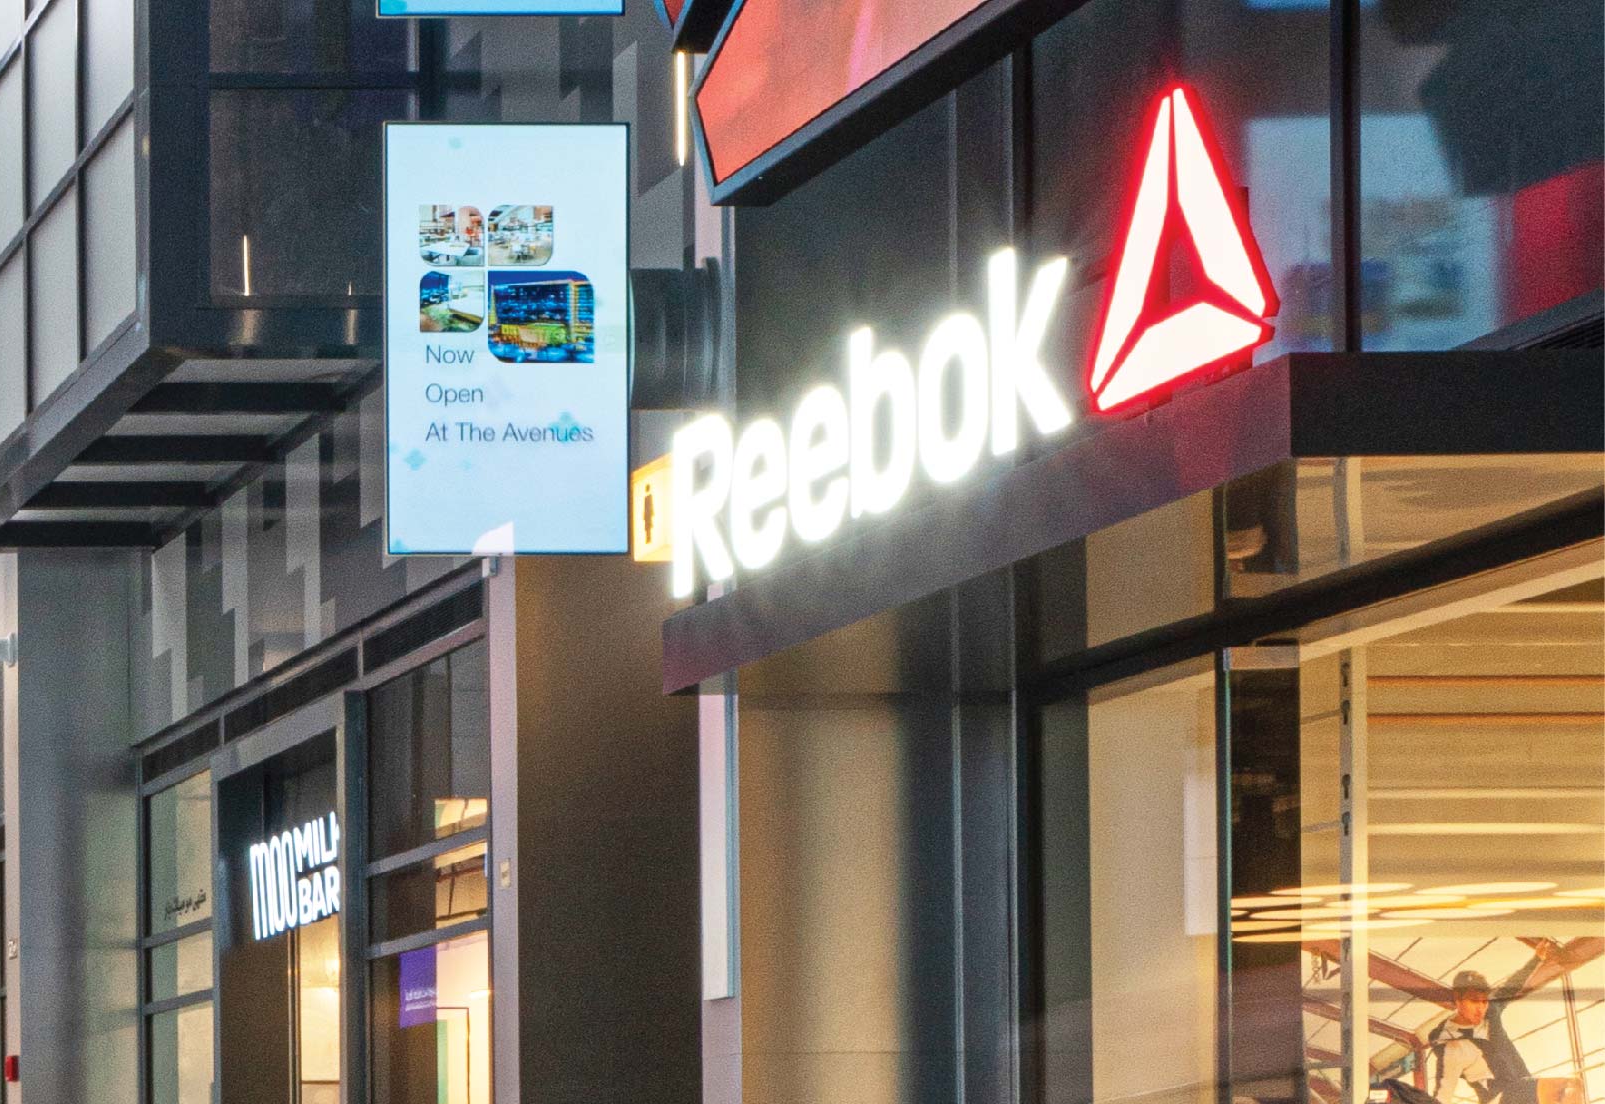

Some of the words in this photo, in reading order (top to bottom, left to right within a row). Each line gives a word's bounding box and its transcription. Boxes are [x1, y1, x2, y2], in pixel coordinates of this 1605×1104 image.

[425, 344, 475, 364] Now
[425, 383, 484, 406] Open
[425, 422, 448, 442] At
[455, 422, 496, 442] The
[502, 422, 594, 442] Avenues
[671, 247, 1074, 599] Reebok
[297, 865, 340, 925] BAR
